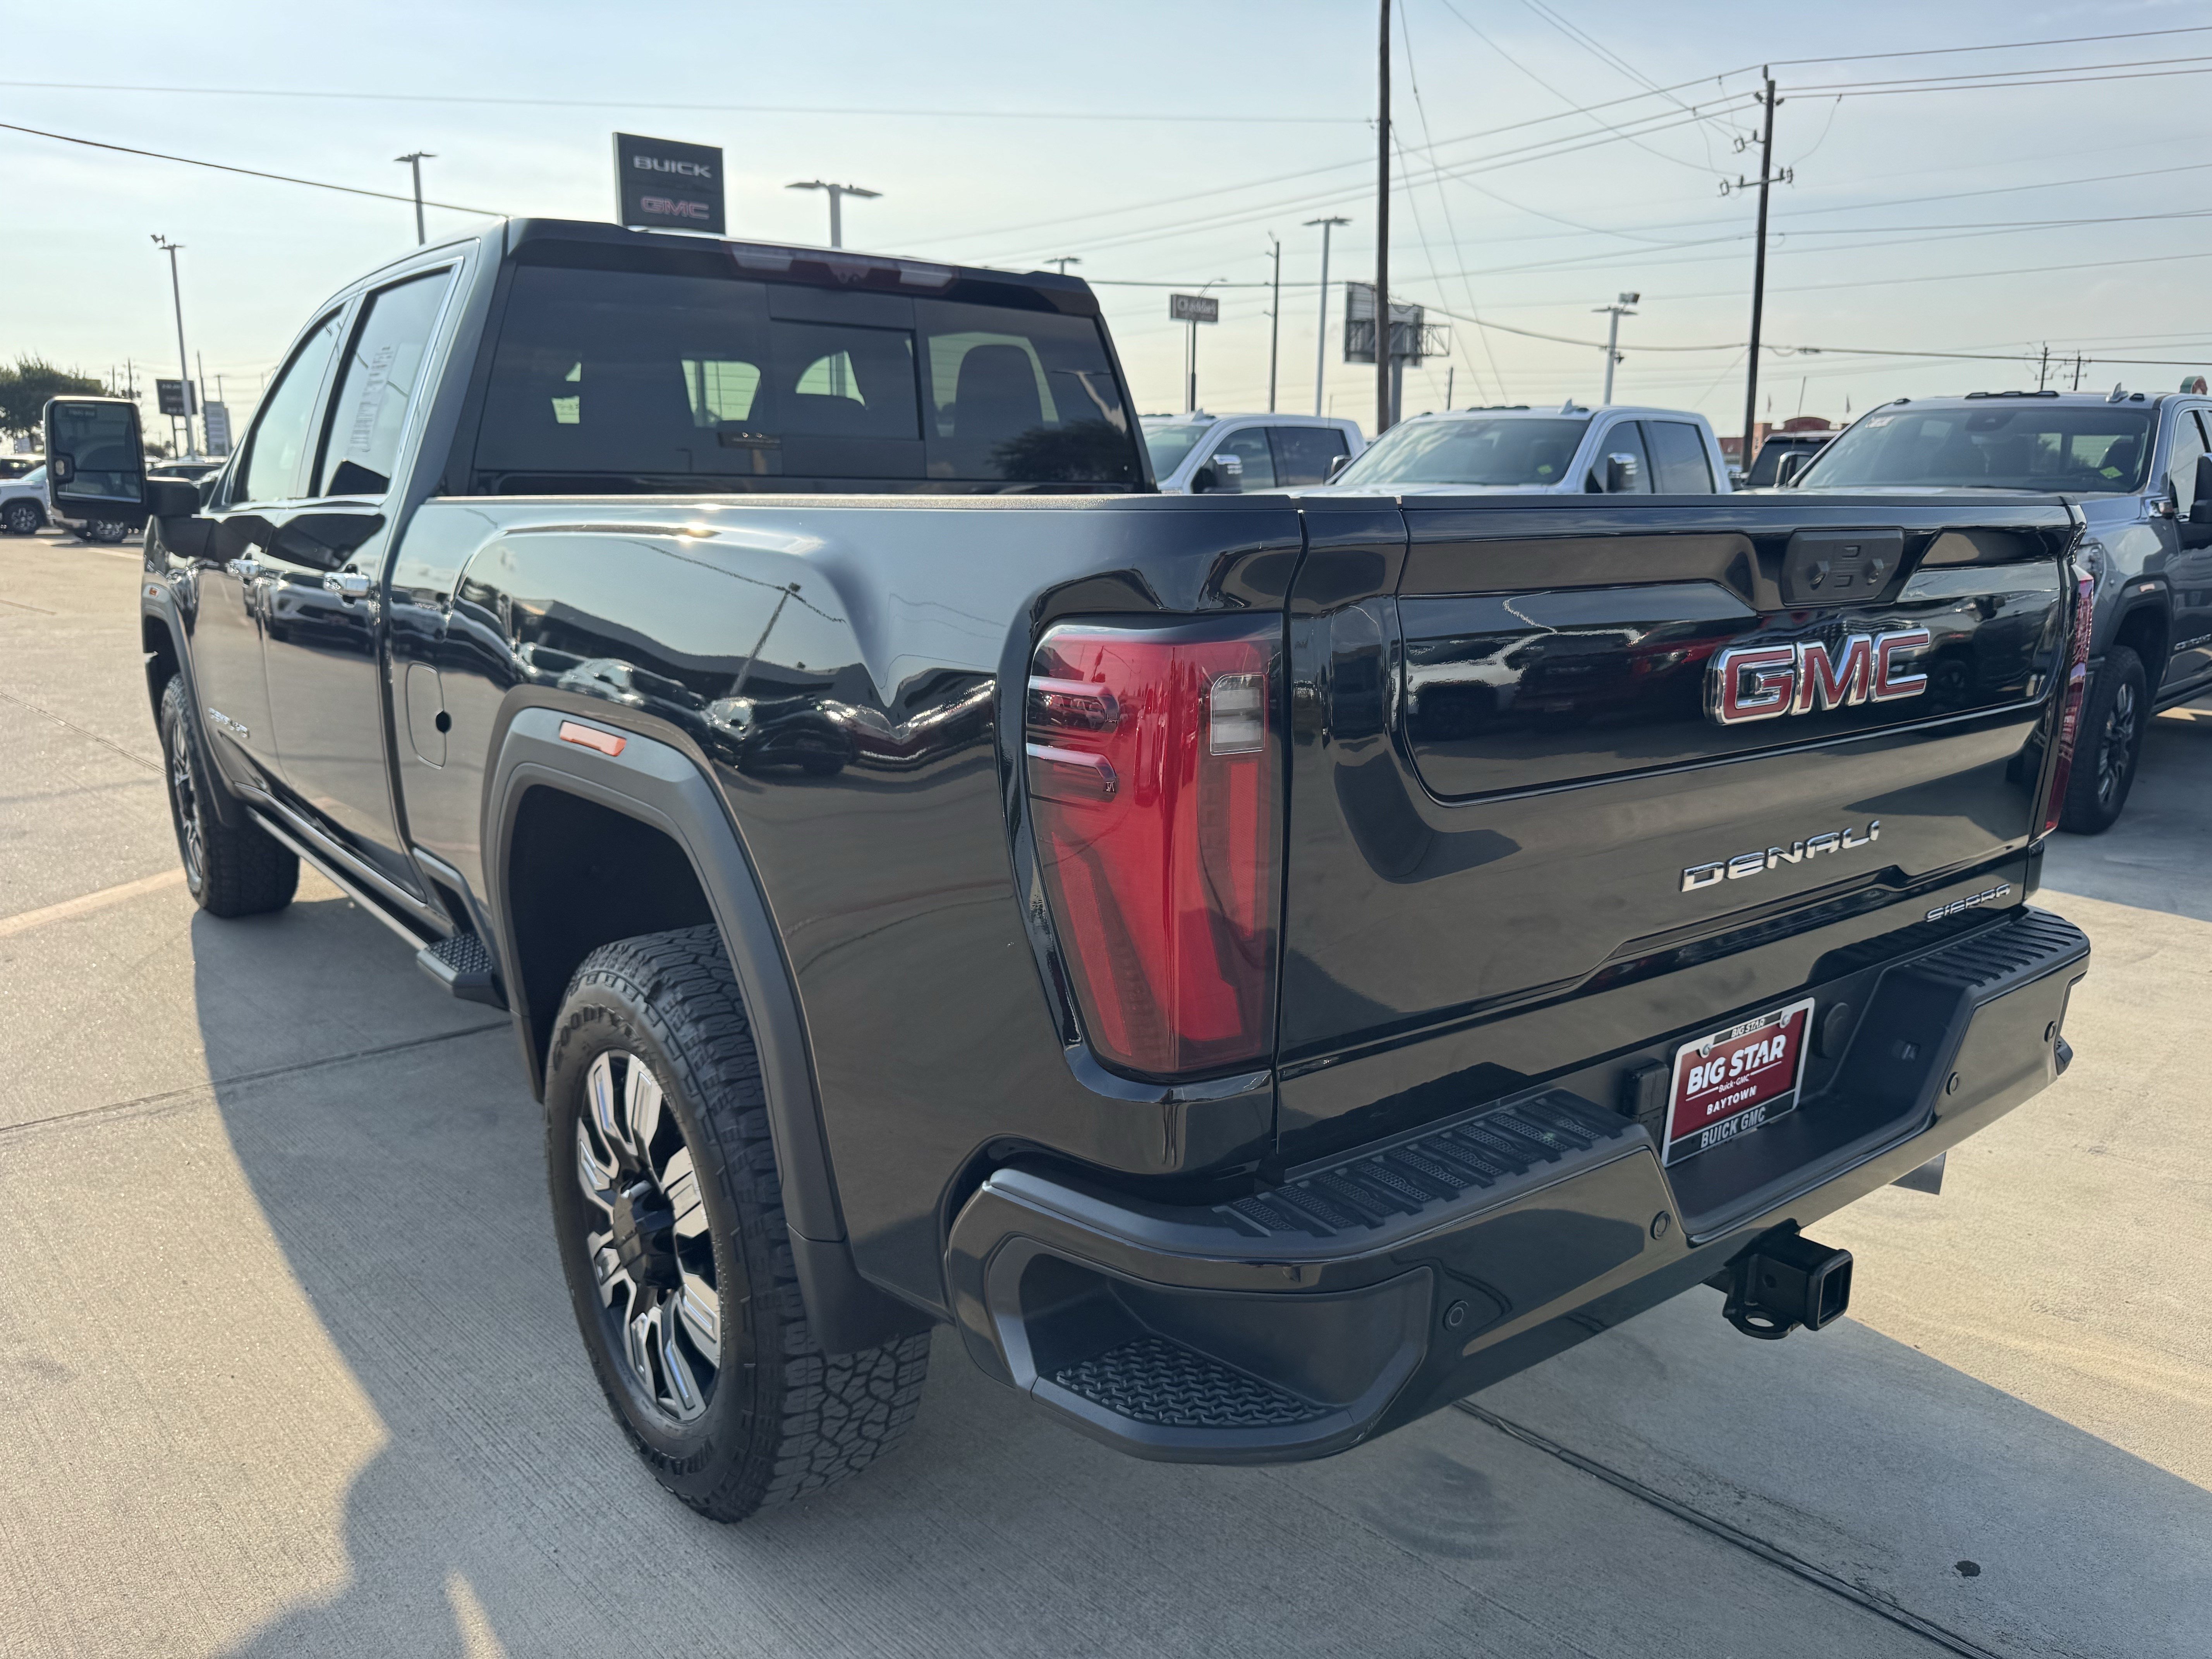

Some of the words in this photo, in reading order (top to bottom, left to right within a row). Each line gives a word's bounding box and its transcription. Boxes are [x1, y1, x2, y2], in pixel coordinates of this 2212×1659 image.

[634, 156, 711, 178] BUICK
[642, 197, 709, 220] GMC
[1716, 627, 1930, 725] GMC
[1681, 820, 1880, 892] DENALI
[1926, 883, 2010, 922] SIERRA
[1731, 1025, 1745, 1038] BIG
[1745, 1018, 1765, 1032] STAR
[1686, 1057, 1726, 1095] BIG
[1729, 1034, 1786, 1077] STAR
[1707, 1085, 1757, 1115] BAYTOWN
[1700, 1118, 1739, 1148] BUICK
[1741, 1106, 1766, 1130] GMC
